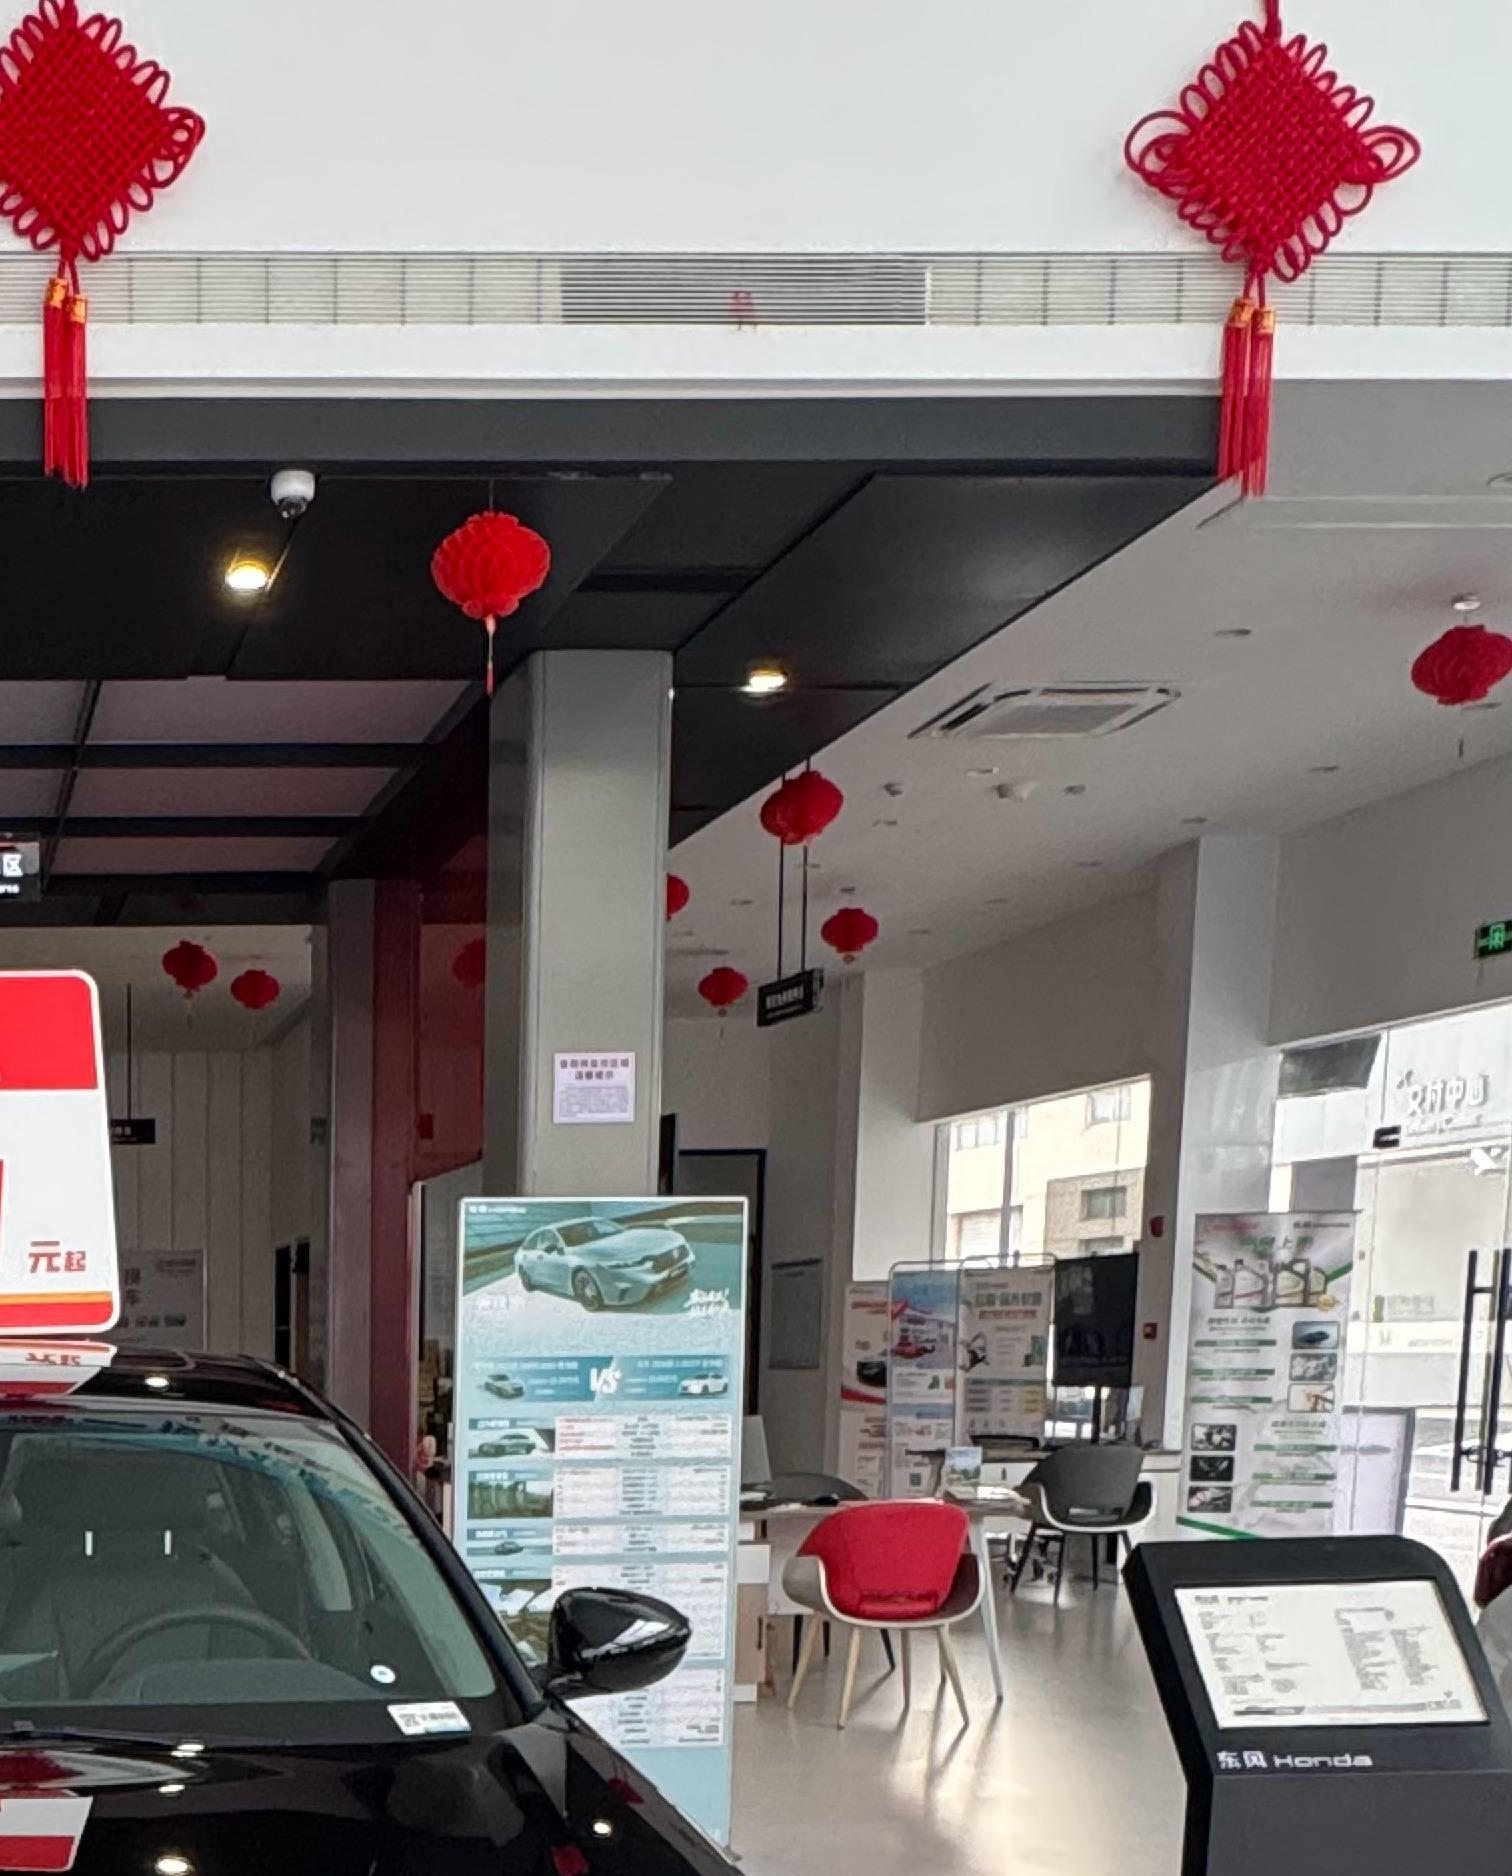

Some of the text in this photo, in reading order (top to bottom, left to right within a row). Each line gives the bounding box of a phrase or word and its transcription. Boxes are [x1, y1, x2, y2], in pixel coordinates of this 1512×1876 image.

[28, 1240, 86, 1275] 元起
[1216, 1750, 1374, 1770] 东风 Honda
